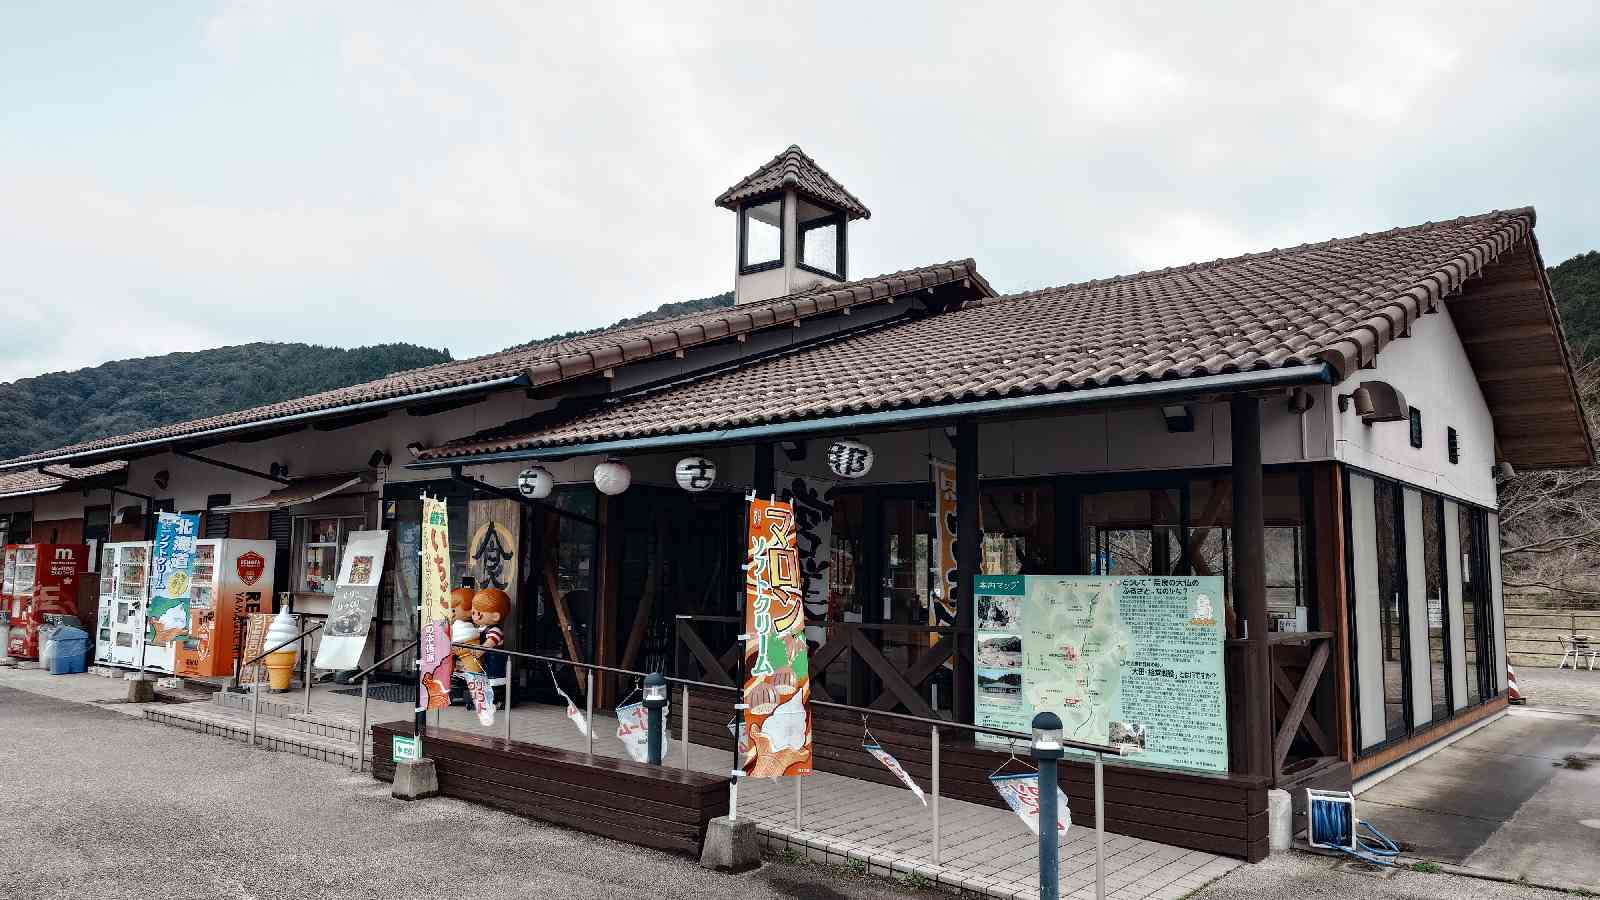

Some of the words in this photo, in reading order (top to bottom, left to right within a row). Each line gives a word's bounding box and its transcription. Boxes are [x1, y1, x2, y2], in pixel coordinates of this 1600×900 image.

[171, 519, 193, 569] 北海道
[764, 506, 802, 638] メロン
[979, 579, 1020, 591] 案内マップ
[752, 535, 774, 677] ソフトクリーム
